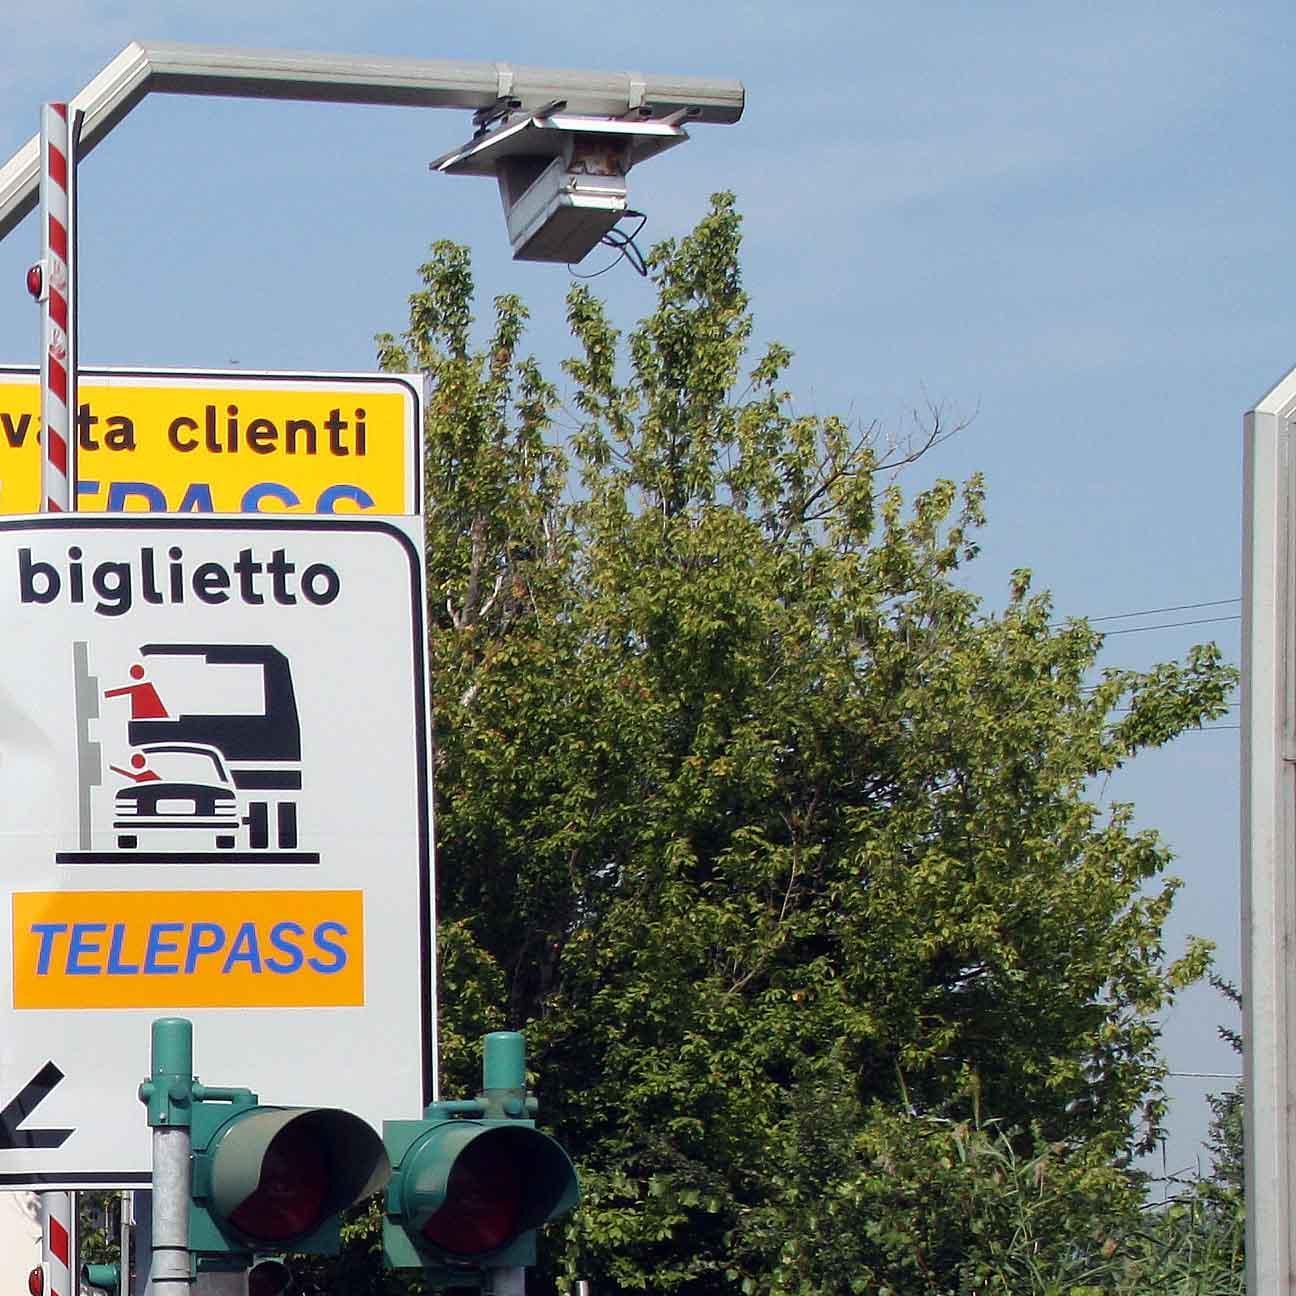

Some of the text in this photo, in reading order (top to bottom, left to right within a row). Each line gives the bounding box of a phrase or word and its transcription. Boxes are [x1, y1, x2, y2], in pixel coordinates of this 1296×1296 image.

[168, 404, 367, 457] clienti
[18, 546, 341, 615] biglietto
[31, 922, 349, 975] TELEPASS
